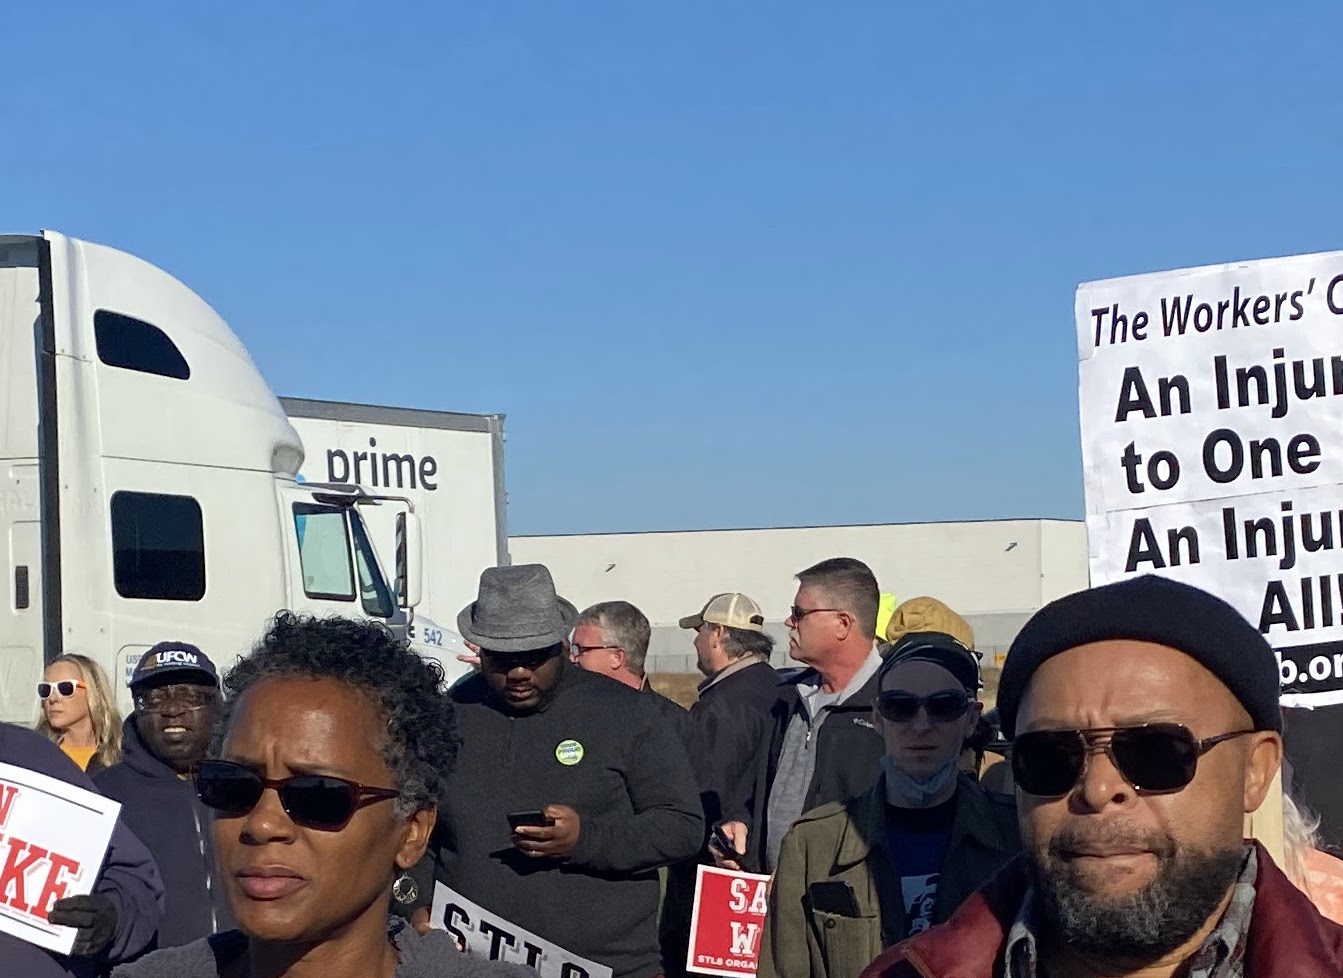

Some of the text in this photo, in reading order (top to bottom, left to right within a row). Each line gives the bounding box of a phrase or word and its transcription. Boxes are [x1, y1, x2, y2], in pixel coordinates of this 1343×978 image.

[1091, 303, 1149, 347] The
[1115, 366, 1192, 422] An
[327, 437, 437, 491] prime
[1121, 441, 1180, 494] to
[1203, 428, 1321, 483] One
[1124, 518, 1201, 573] An
[424, 627, 442, 646] 542
